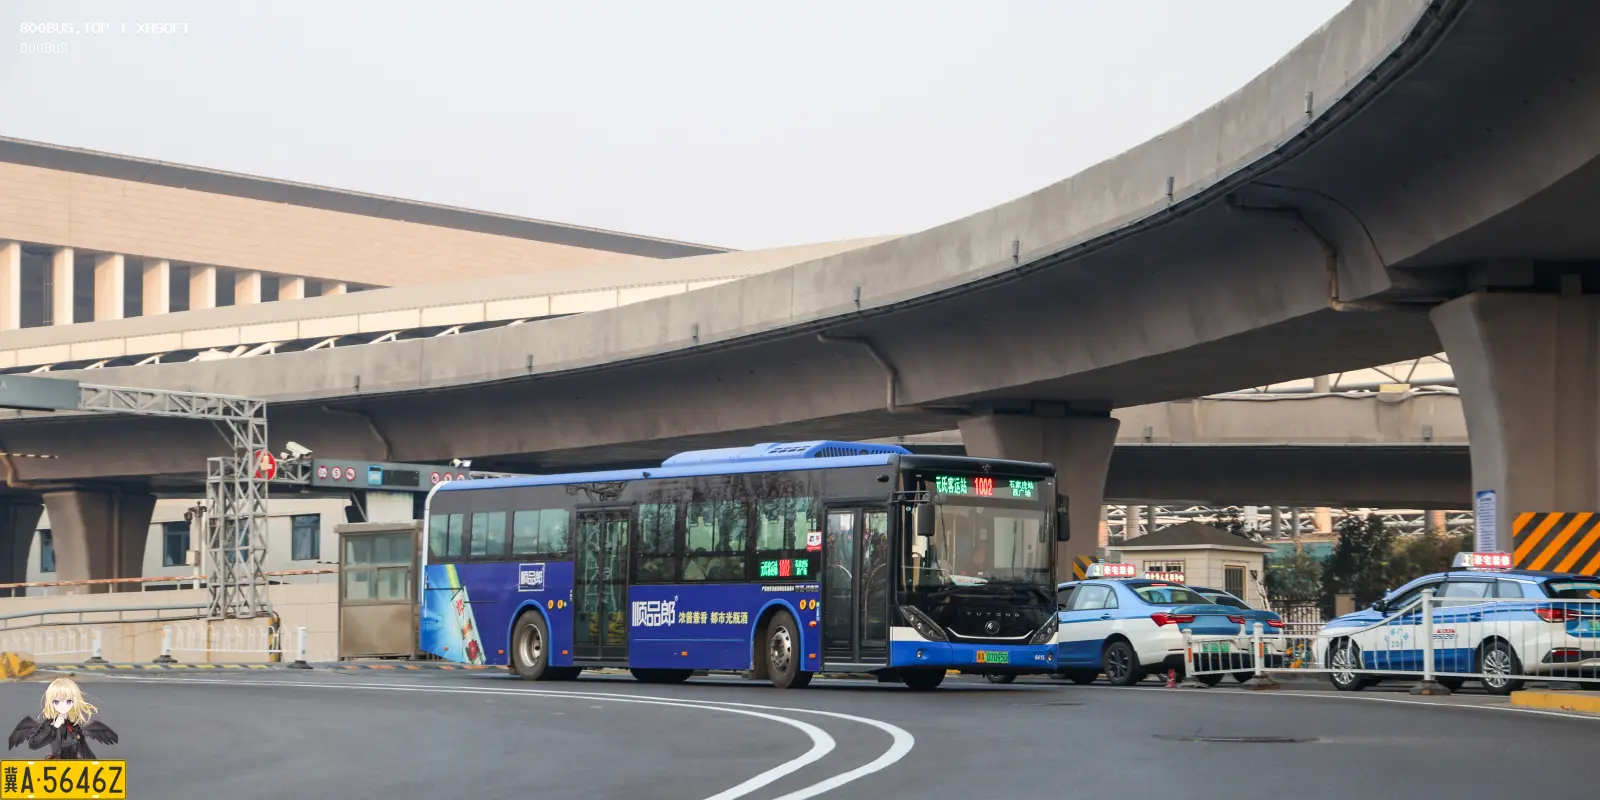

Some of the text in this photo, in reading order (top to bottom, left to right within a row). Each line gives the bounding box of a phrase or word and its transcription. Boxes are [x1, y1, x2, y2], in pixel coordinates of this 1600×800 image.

[935, 476, 993, 496] 元氏客运站 1002
[1009, 480, 1034, 490] 石家庄站
[1012, 488, 1032, 498] 西广场
[520, 570, 543, 585] 顺品郎
[631, 599, 676, 627] 顺品郎
[678, 611, 749, 625] 浓酱兼香 都市光瓶酒
